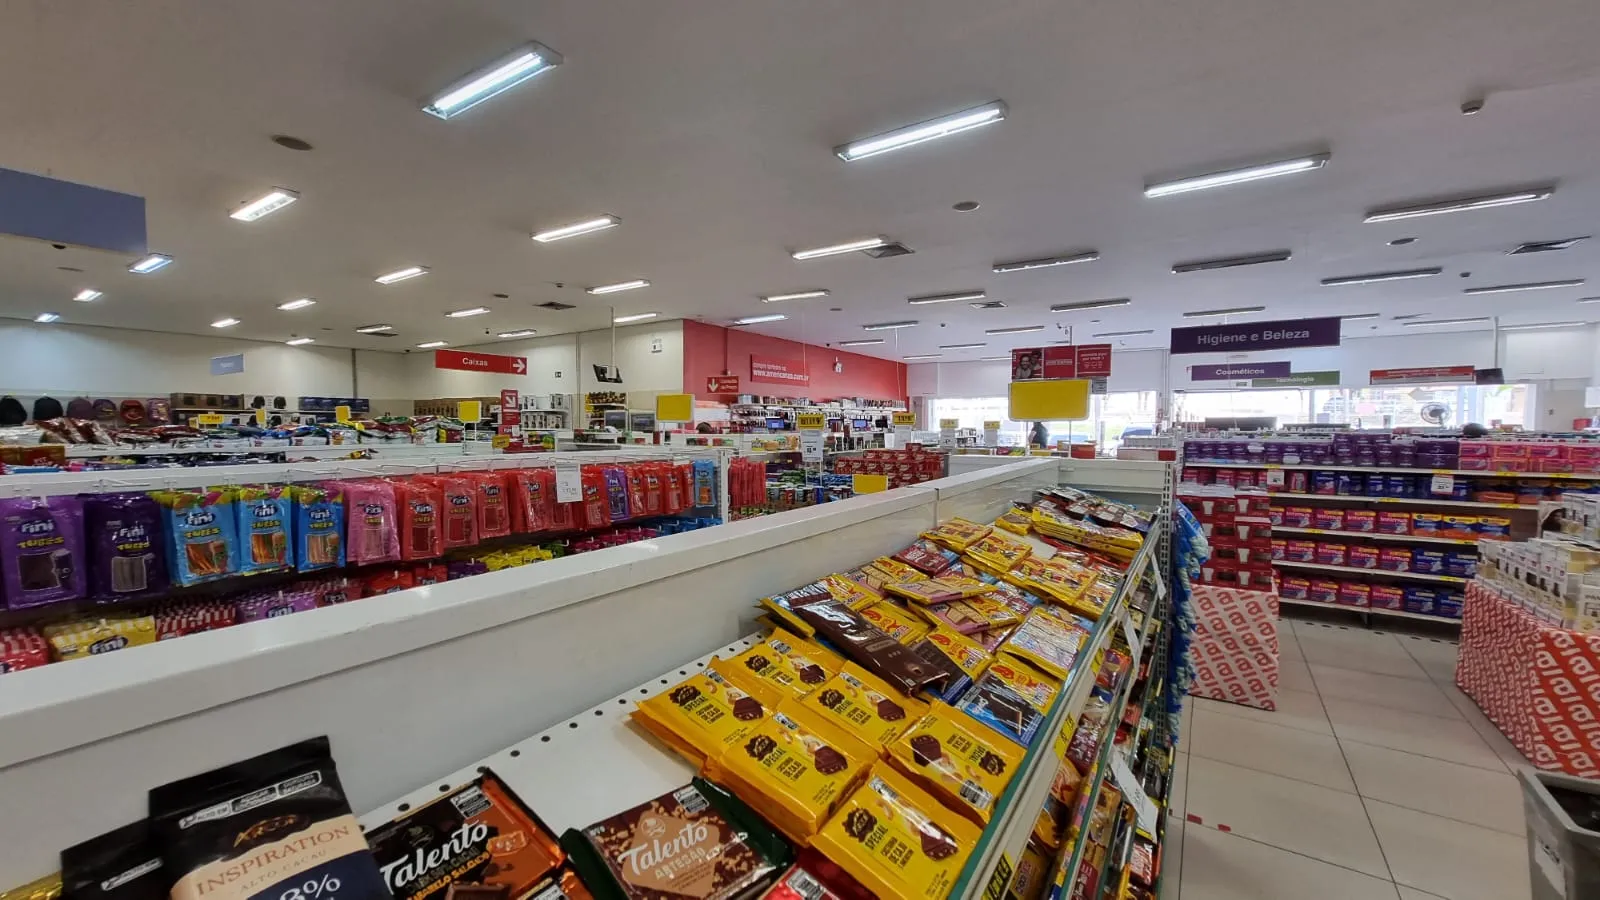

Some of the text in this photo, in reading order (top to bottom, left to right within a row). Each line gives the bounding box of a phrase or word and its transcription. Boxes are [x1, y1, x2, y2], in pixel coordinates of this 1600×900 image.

[1197, 330, 1310, 346] Higiene e Beleza
[462, 357, 488, 367] Caixas
[1216, 368, 1264, 376] Cosméticos
[254, 504, 276, 516] Fini
[310, 509, 330, 519] Fini
[188, 512, 213, 525] Fini
[21, 520, 54, 534] Fini
[120, 524, 145, 538] Fini
[92, 636, 124, 654] Fini
[684, 694, 709, 711] SPECIAL
[762, 748, 786, 768] SPECIAL
[864, 824, 888, 850] SPECIAL
[617, 817, 708, 875] Talento
[196, 826, 350, 897] INSPIRATION
[379, 820, 488, 896] Talento
[656, 847, 706, 880] ARTESÃO
